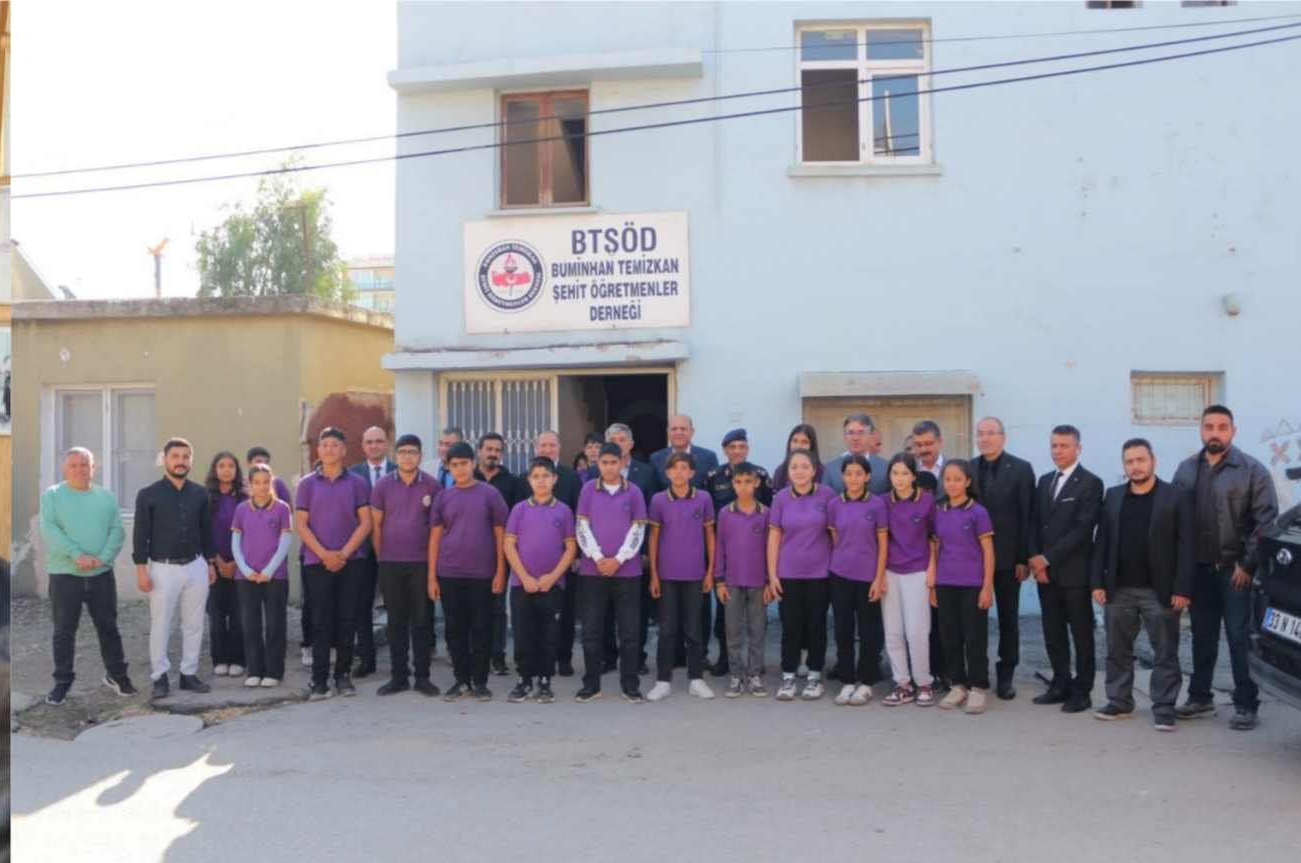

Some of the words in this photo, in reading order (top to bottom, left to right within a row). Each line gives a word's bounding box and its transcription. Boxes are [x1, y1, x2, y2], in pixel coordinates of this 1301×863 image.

[551, 257, 614, 278] BUMİNHAN
[618, 254, 679, 275] TEMİZKAN
[553, 279, 587, 304] ŞEHİT
[590, 278, 678, 299] ÖĞRETMENLER
[590, 300, 641, 321] DERNEĞİ
[1269, 611, 1280, 630] 33
